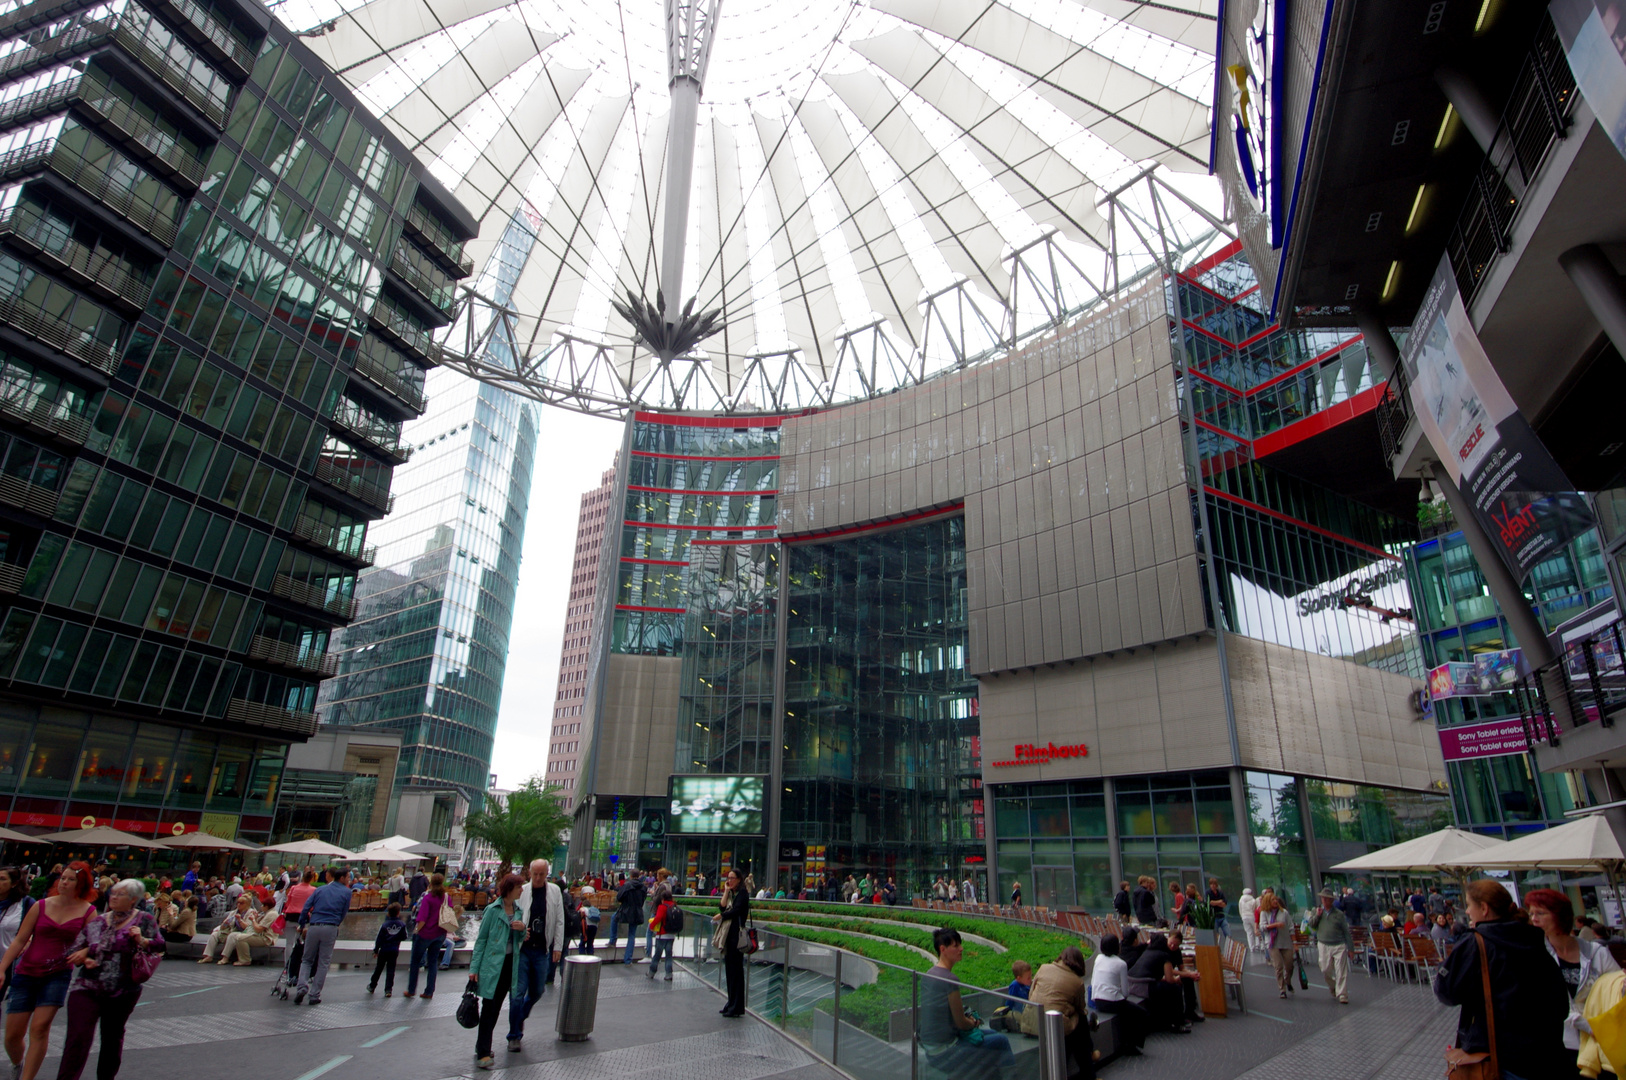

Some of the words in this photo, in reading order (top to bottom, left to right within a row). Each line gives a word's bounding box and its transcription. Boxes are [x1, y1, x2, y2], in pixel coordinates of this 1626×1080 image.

[1459, 422, 1485, 462] RESCUE
[1499, 451, 1522, 475] LEINWAND
[1491, 500, 1536, 548] EVENT
[1300, 590, 1347, 617] Sony
[1458, 732, 1476, 741] Sony
[1476, 728, 1499, 738] Tablet
[1014, 742, 1088, 758] Filmhaus
[1461, 745, 1479, 754] Sony
[1480, 742, 1502, 751] Tablet
[204, 814, 237, 823] RESTAURANT
